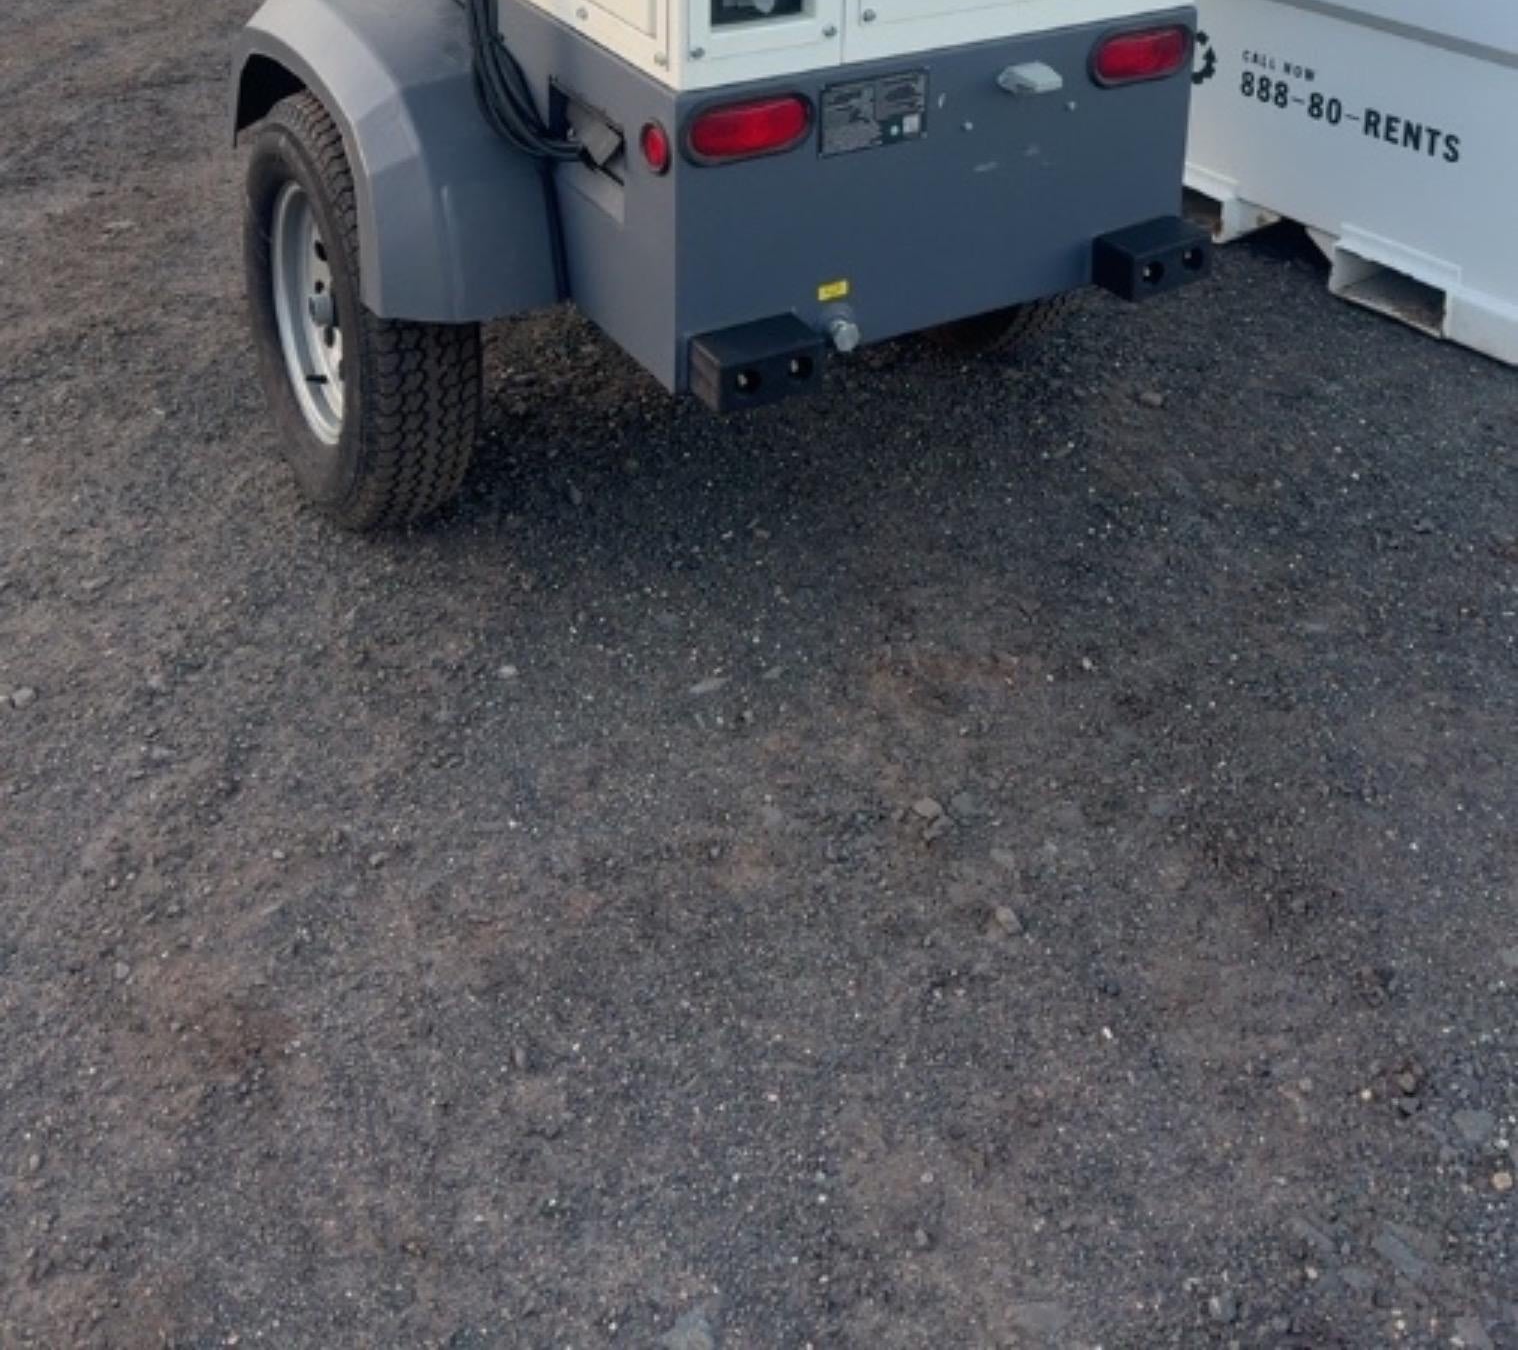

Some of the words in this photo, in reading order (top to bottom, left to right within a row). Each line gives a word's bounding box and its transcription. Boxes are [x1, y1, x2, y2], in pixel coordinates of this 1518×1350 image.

[1242, 50, 1276, 70] CALL
[1283, 62, 1316, 82] NOW
[1241, 71, 1461, 163] 888-80-RENTS
